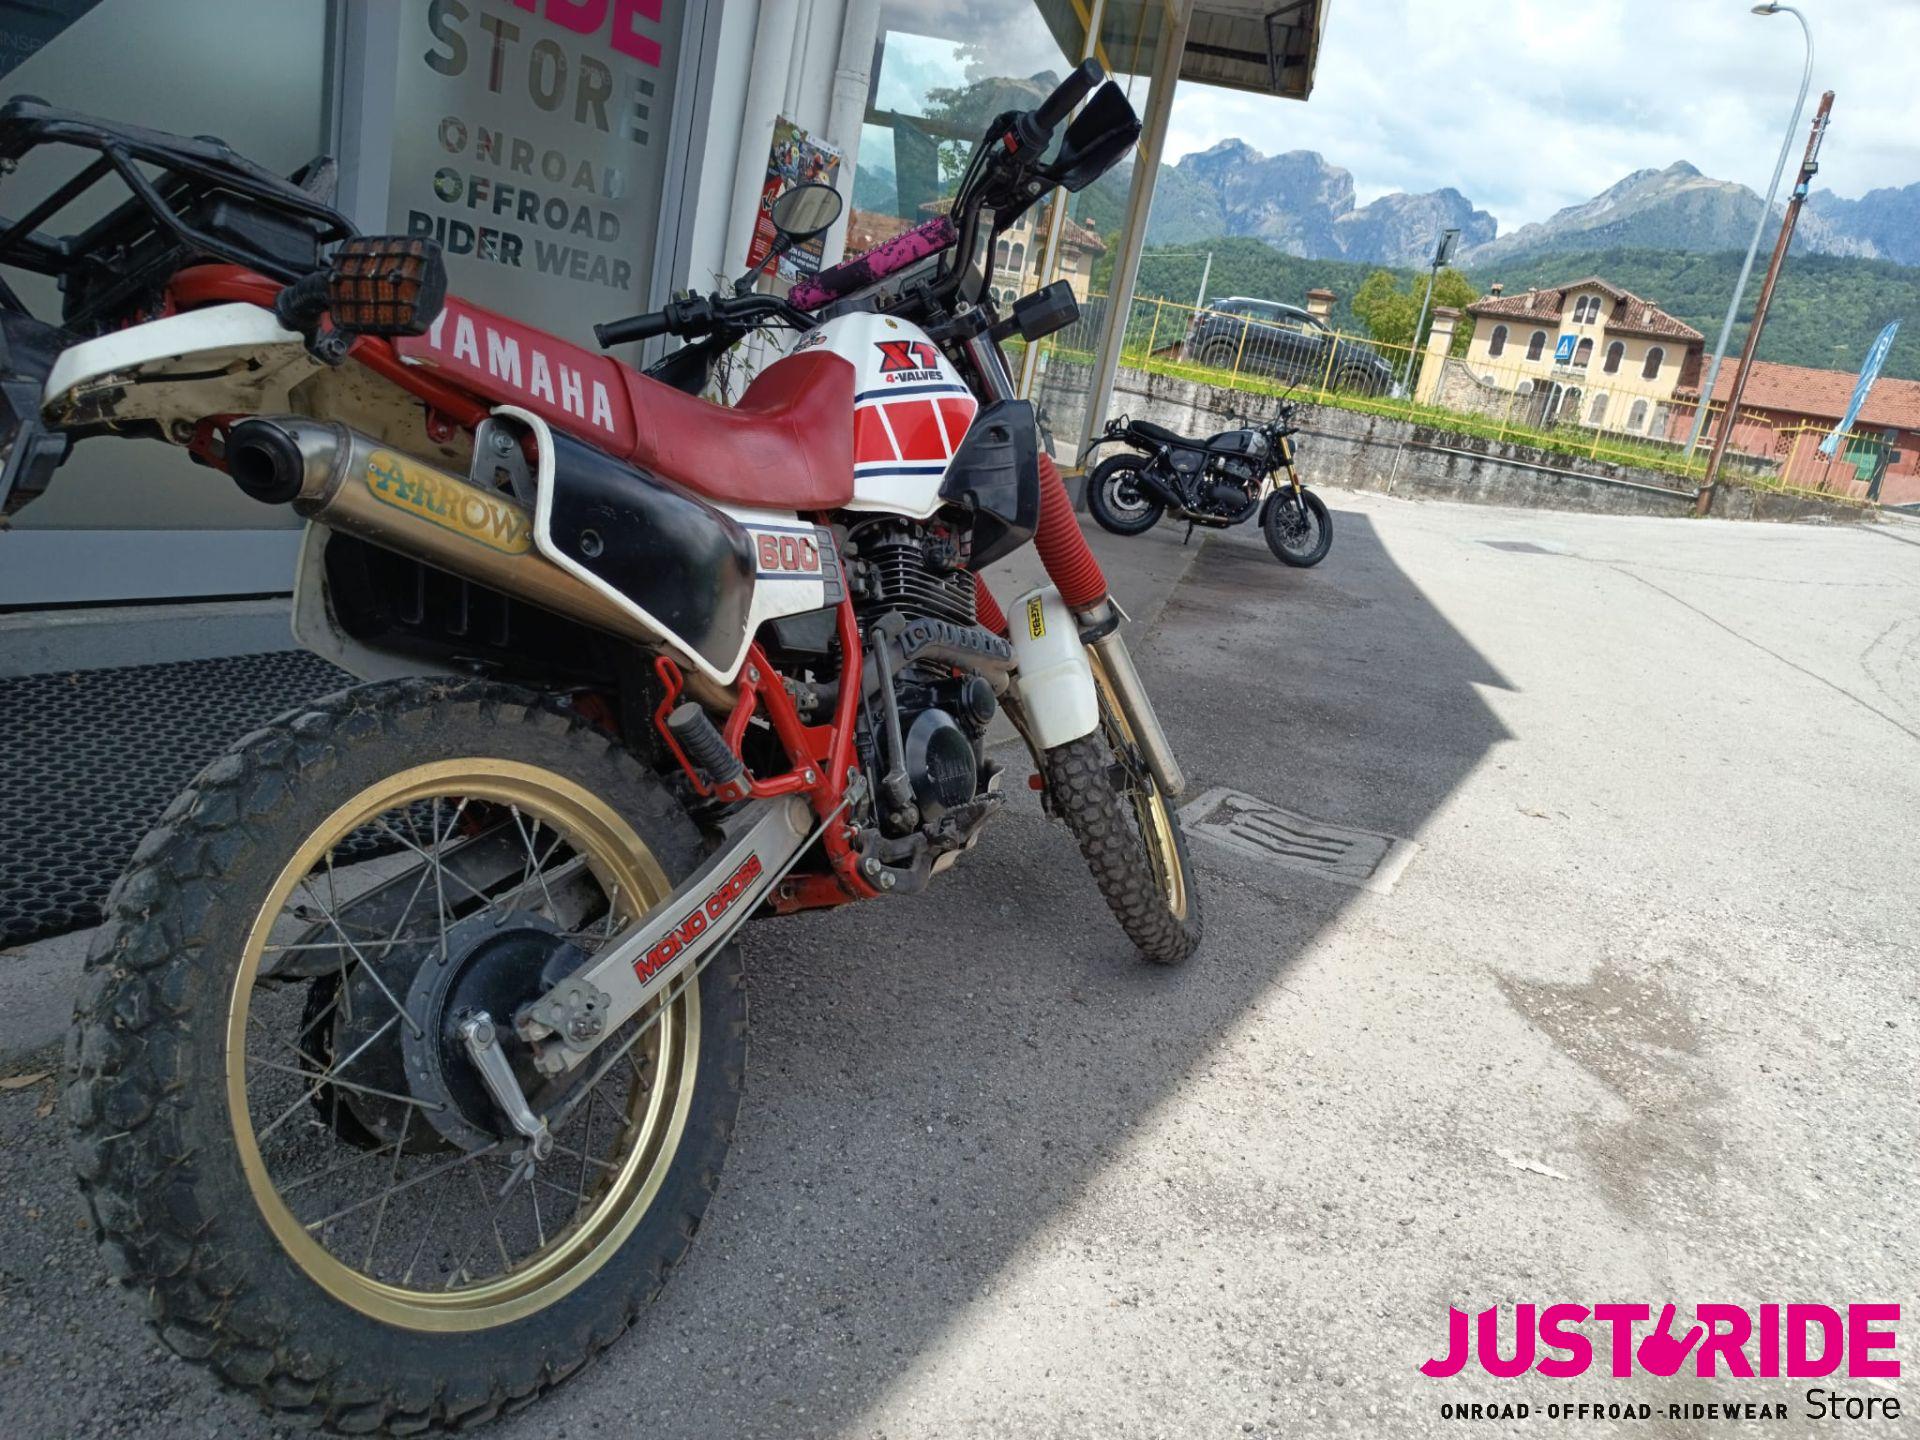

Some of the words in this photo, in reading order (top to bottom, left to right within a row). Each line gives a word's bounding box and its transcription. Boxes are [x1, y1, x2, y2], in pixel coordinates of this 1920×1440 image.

[424, 0, 656, 147] STORE
[438, 116, 625, 201] ONROAD
[433, 166, 621, 243] OFFROAD
[407, 209, 524, 268] RIDER
[535, 239, 632, 291] WEAR
[430, 307, 615, 434] YAMAHA
[873, 341, 941, 373] XT
[885, 371, 943, 384] 4-VALVES
[374, 459, 526, 545] ARROW
[757, 534, 819, 571] 600
[633, 909, 707, 984] MONO
[705, 854, 762, 921] CROSS
